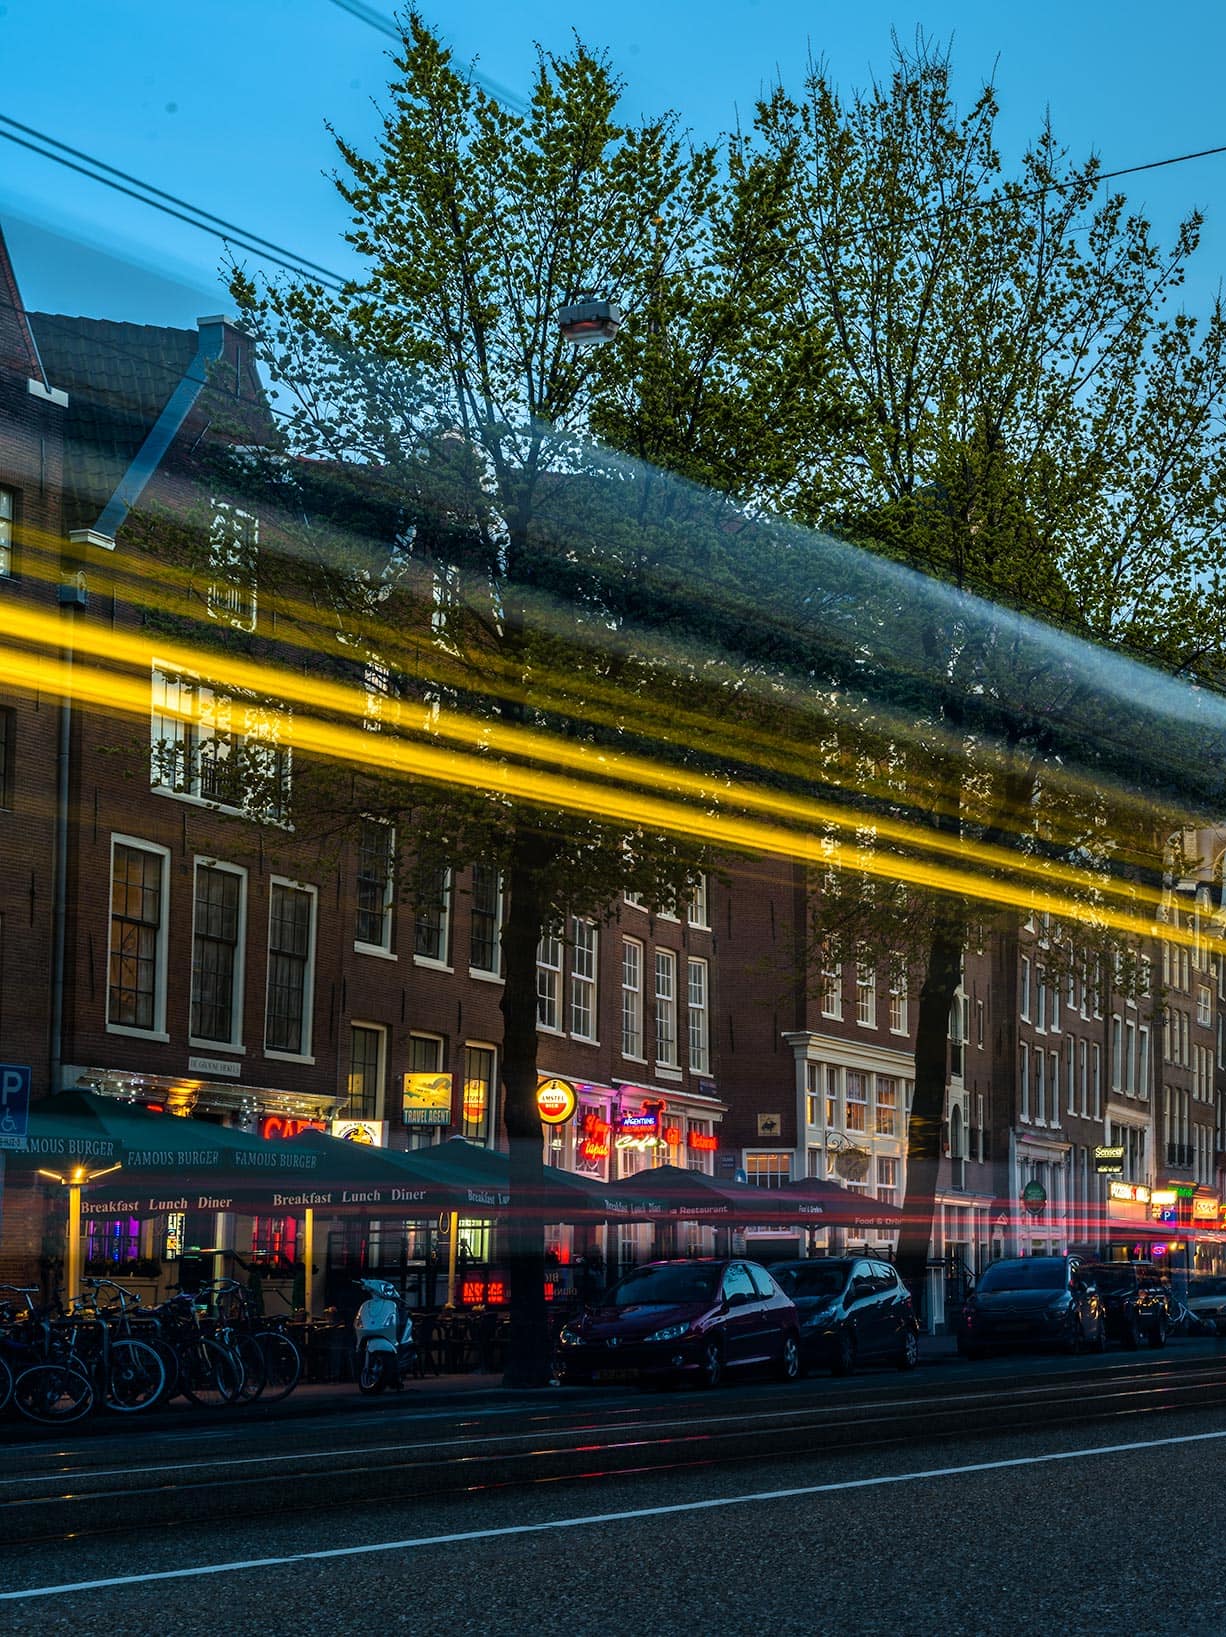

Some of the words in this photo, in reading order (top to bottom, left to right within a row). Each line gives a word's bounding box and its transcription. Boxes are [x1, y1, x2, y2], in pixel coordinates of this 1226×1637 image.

[2, 1071, 23, 1105] P
[404, 1109, 426, 1122] TRAVEL
[428, 1110, 450, 1122] AGENT
[67, 1140, 114, 1157] BURGER
[127, 1151, 172, 1167] FAMOUS
[177, 1151, 219, 1167] BURGER
[235, 1152, 276, 1167] FAMOUS
[279, 1153, 318, 1169] BURGER
[80, 1201, 139, 1213] Breakfast
[149, 1198, 188, 1210] Lunch
[198, 1197, 233, 1208] Diner
[273, 1193, 332, 1206] Breakfast
[342, 1190, 381, 1202] Lunch
[391, 1188, 427, 1200] Diner
